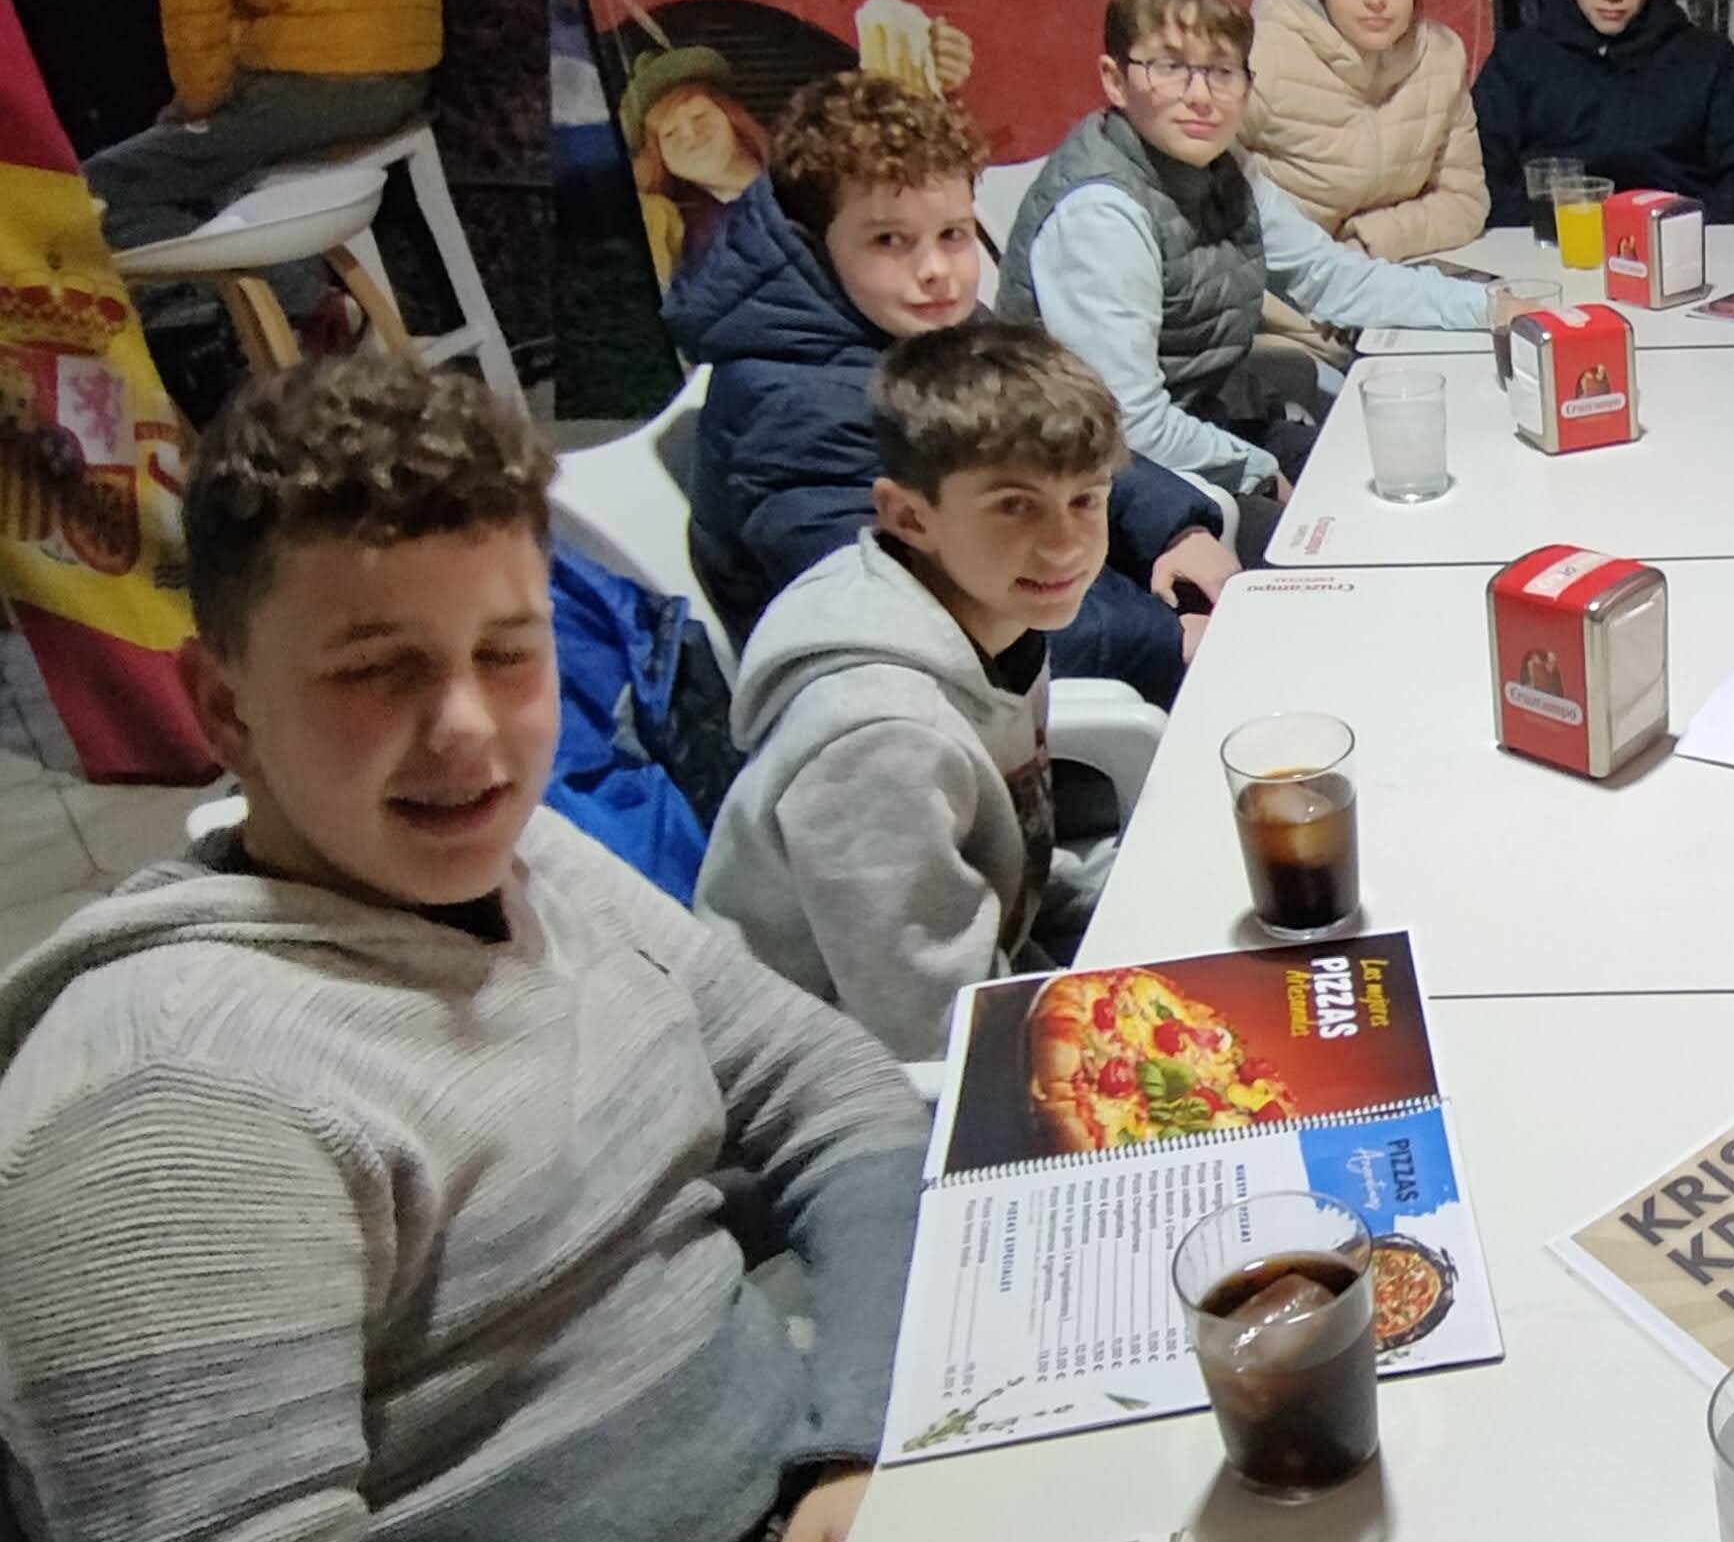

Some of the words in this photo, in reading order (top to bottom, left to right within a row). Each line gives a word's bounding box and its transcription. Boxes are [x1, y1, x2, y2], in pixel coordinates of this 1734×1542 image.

[1509, 687, 1577, 721] Cruzcampo
[1310, 956, 1358, 1040] PIZZAS
[1387, 1138, 1421, 1203] PIZZAS
